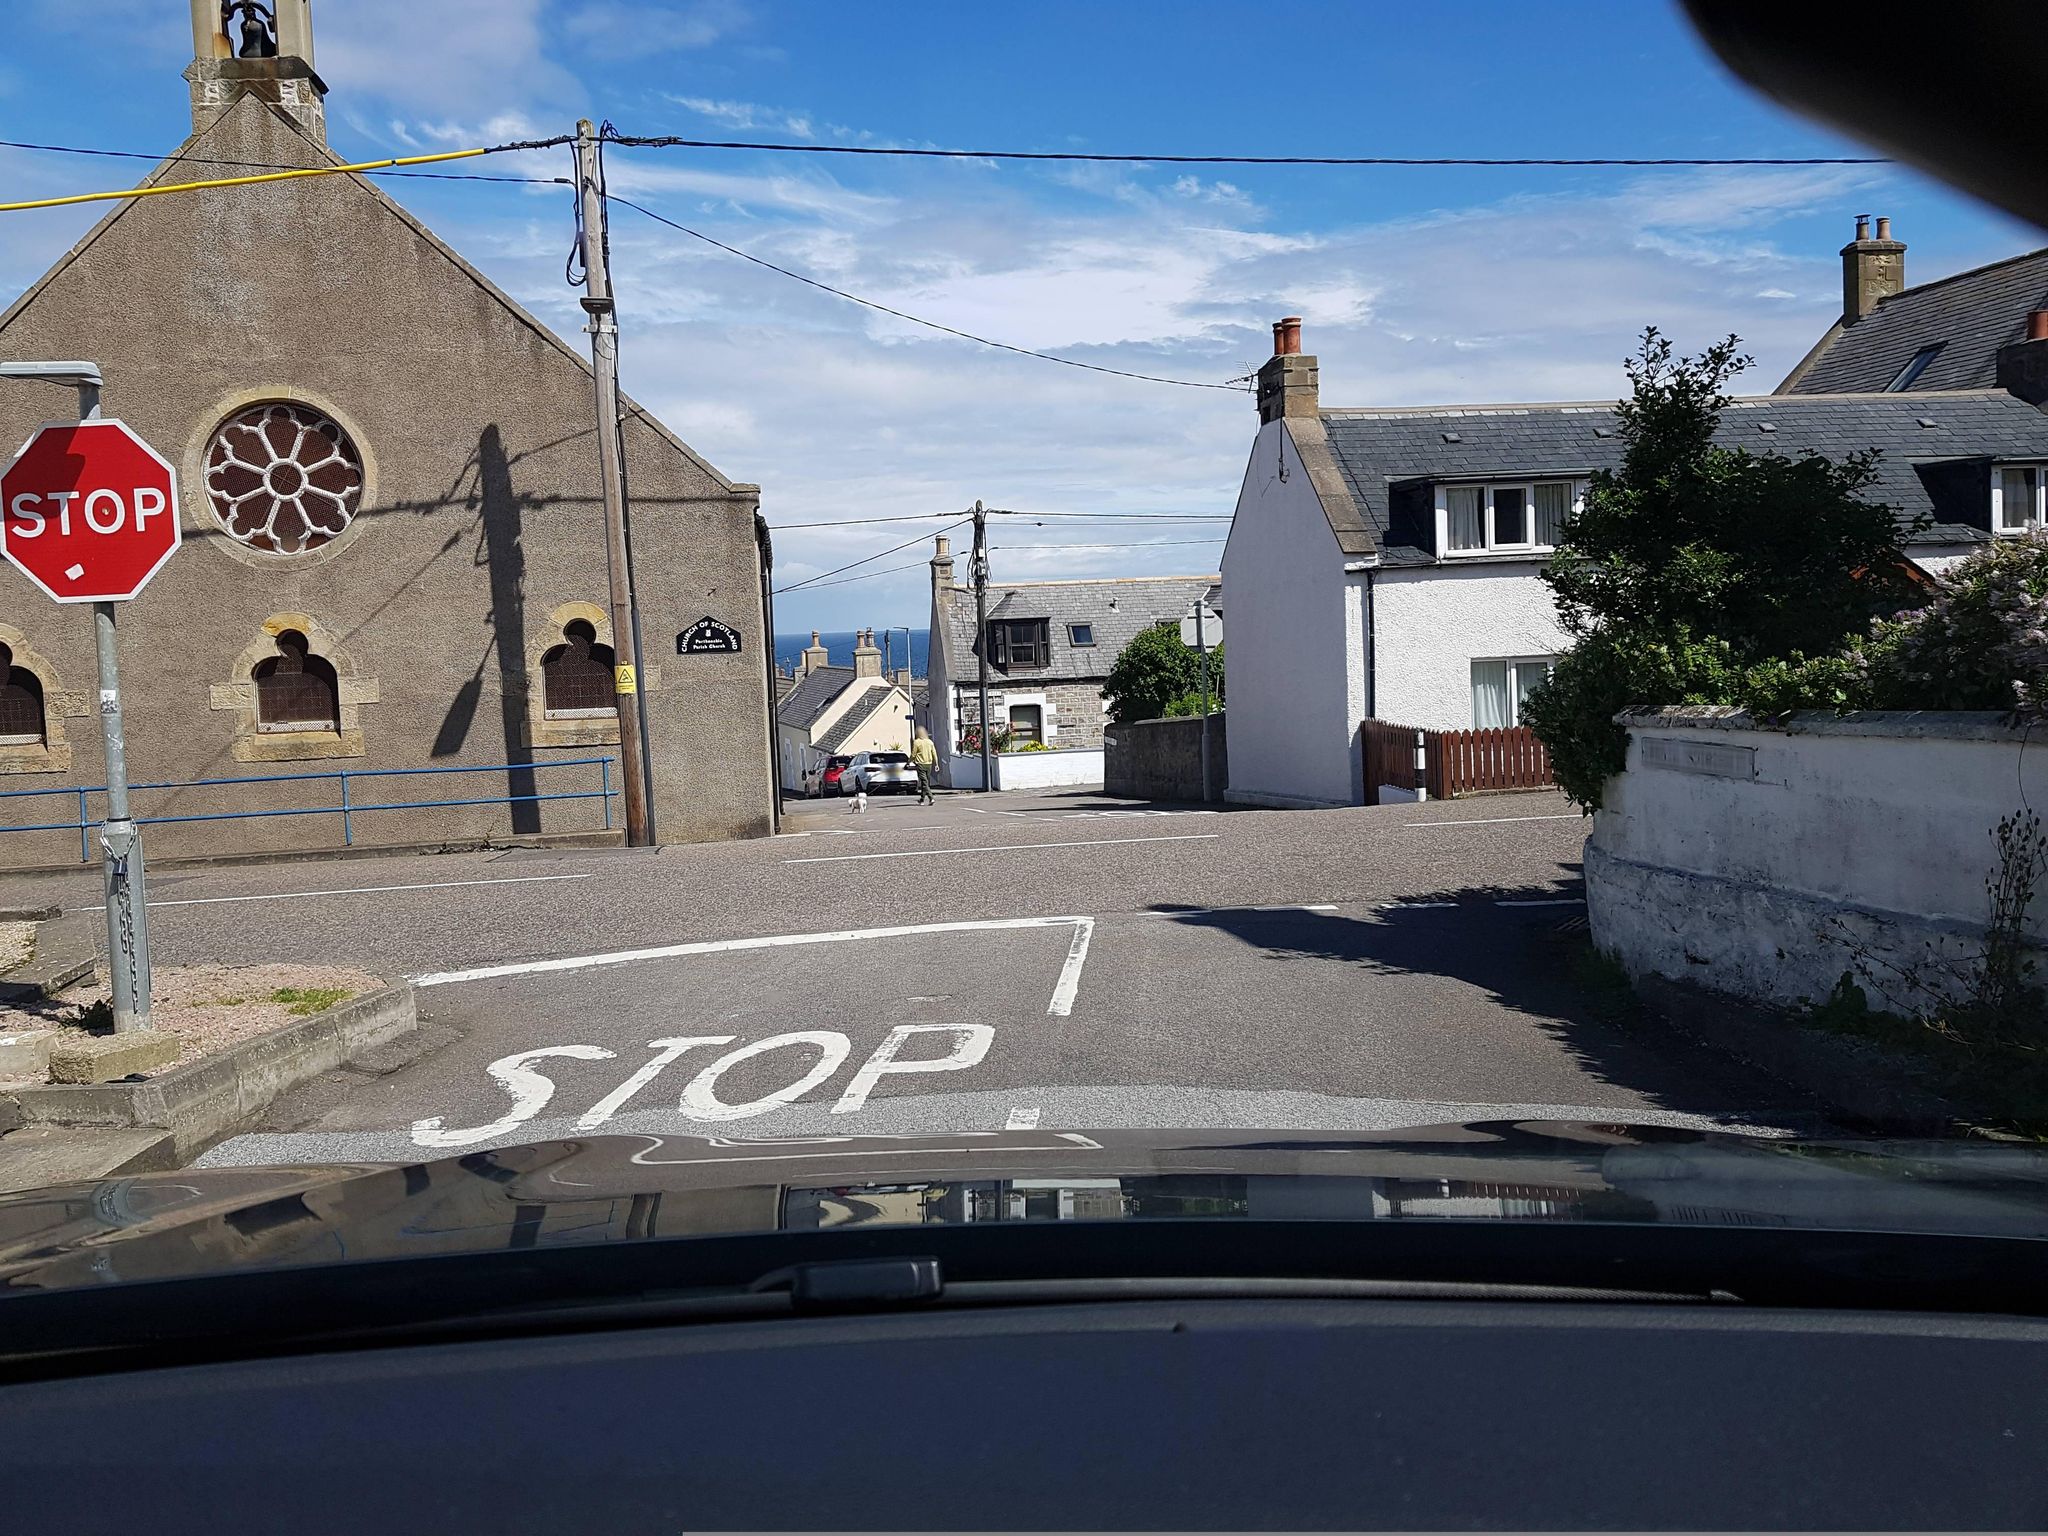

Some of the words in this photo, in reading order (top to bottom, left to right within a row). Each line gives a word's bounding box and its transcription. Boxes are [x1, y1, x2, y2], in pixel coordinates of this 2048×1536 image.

[11, 487, 166, 538] STOP
[681, 625, 698, 652] CHURCH
[711, 621, 738, 650] SCOTLAND
[411, 1023, 996, 1148] STOP
